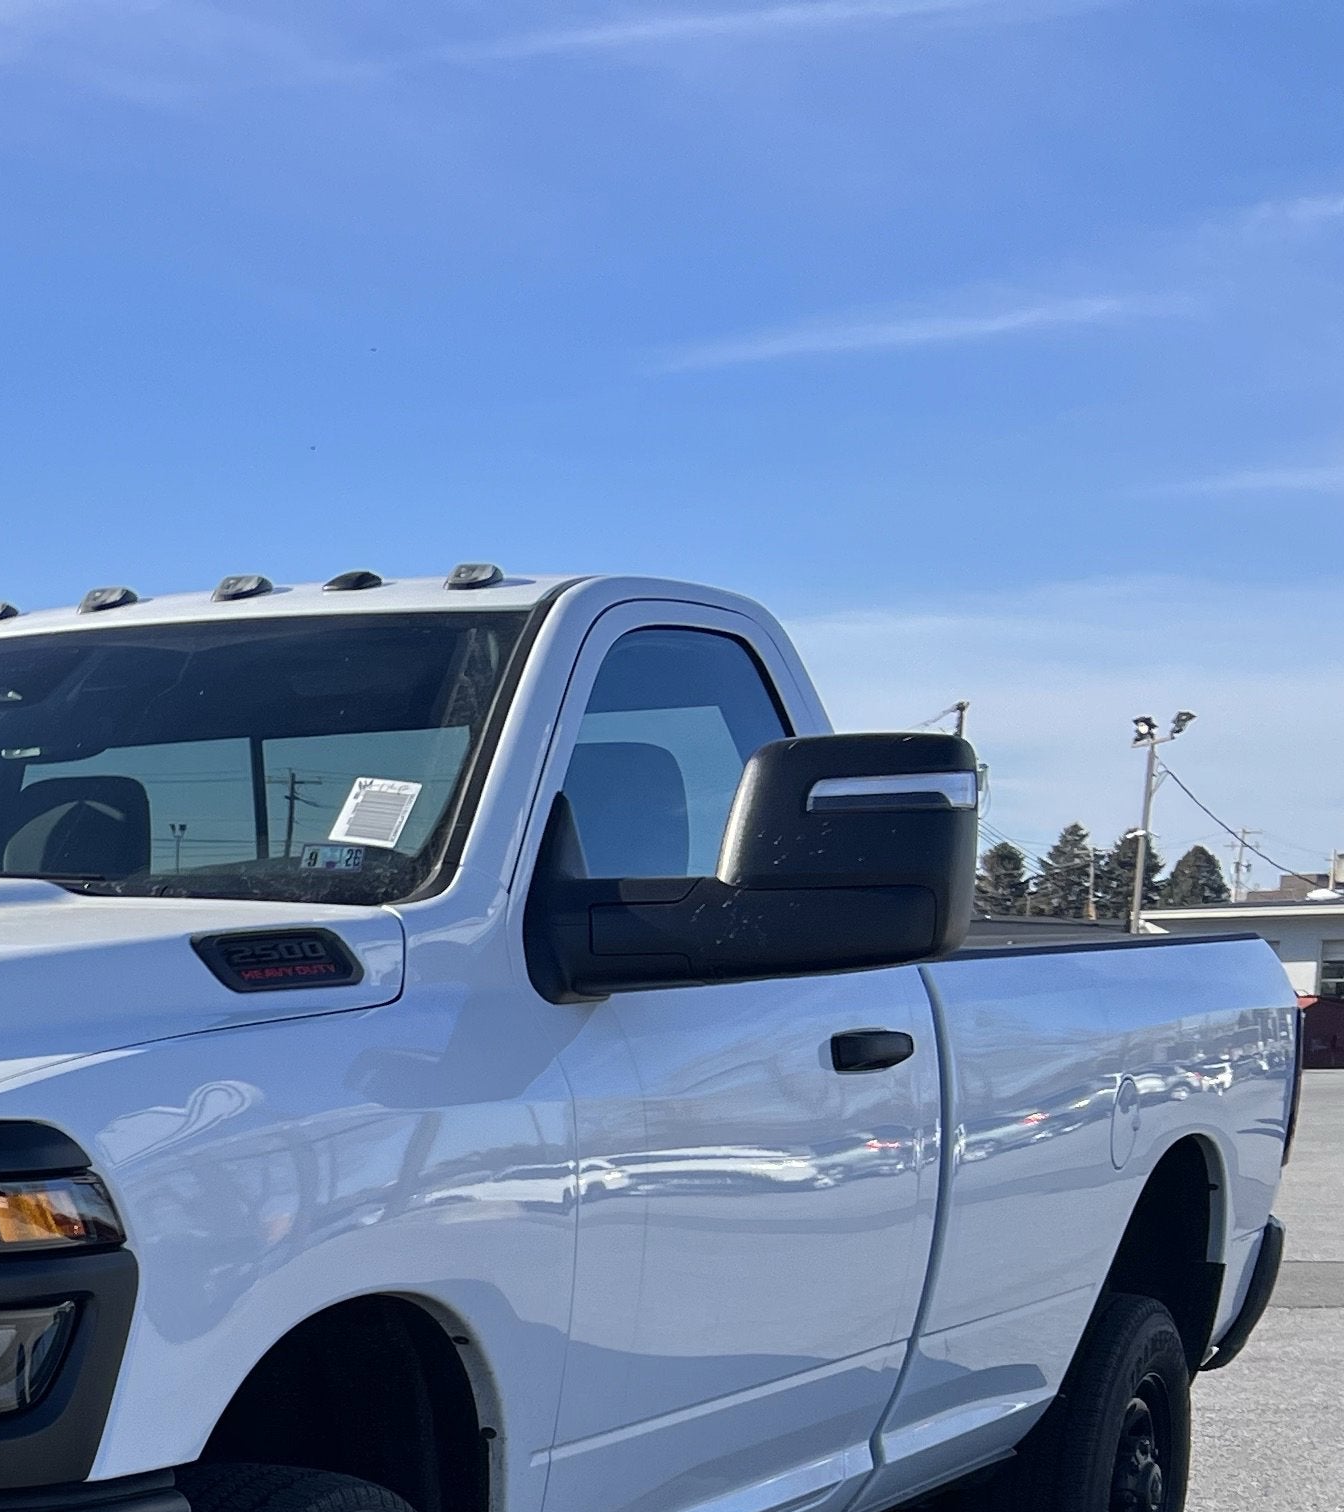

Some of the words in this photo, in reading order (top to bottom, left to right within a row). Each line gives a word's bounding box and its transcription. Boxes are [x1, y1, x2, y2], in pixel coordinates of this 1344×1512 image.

[227, 941, 326, 963] 2500
[240, 966, 293, 980] HEAVY
[294, 963, 336, 976] DUTY
